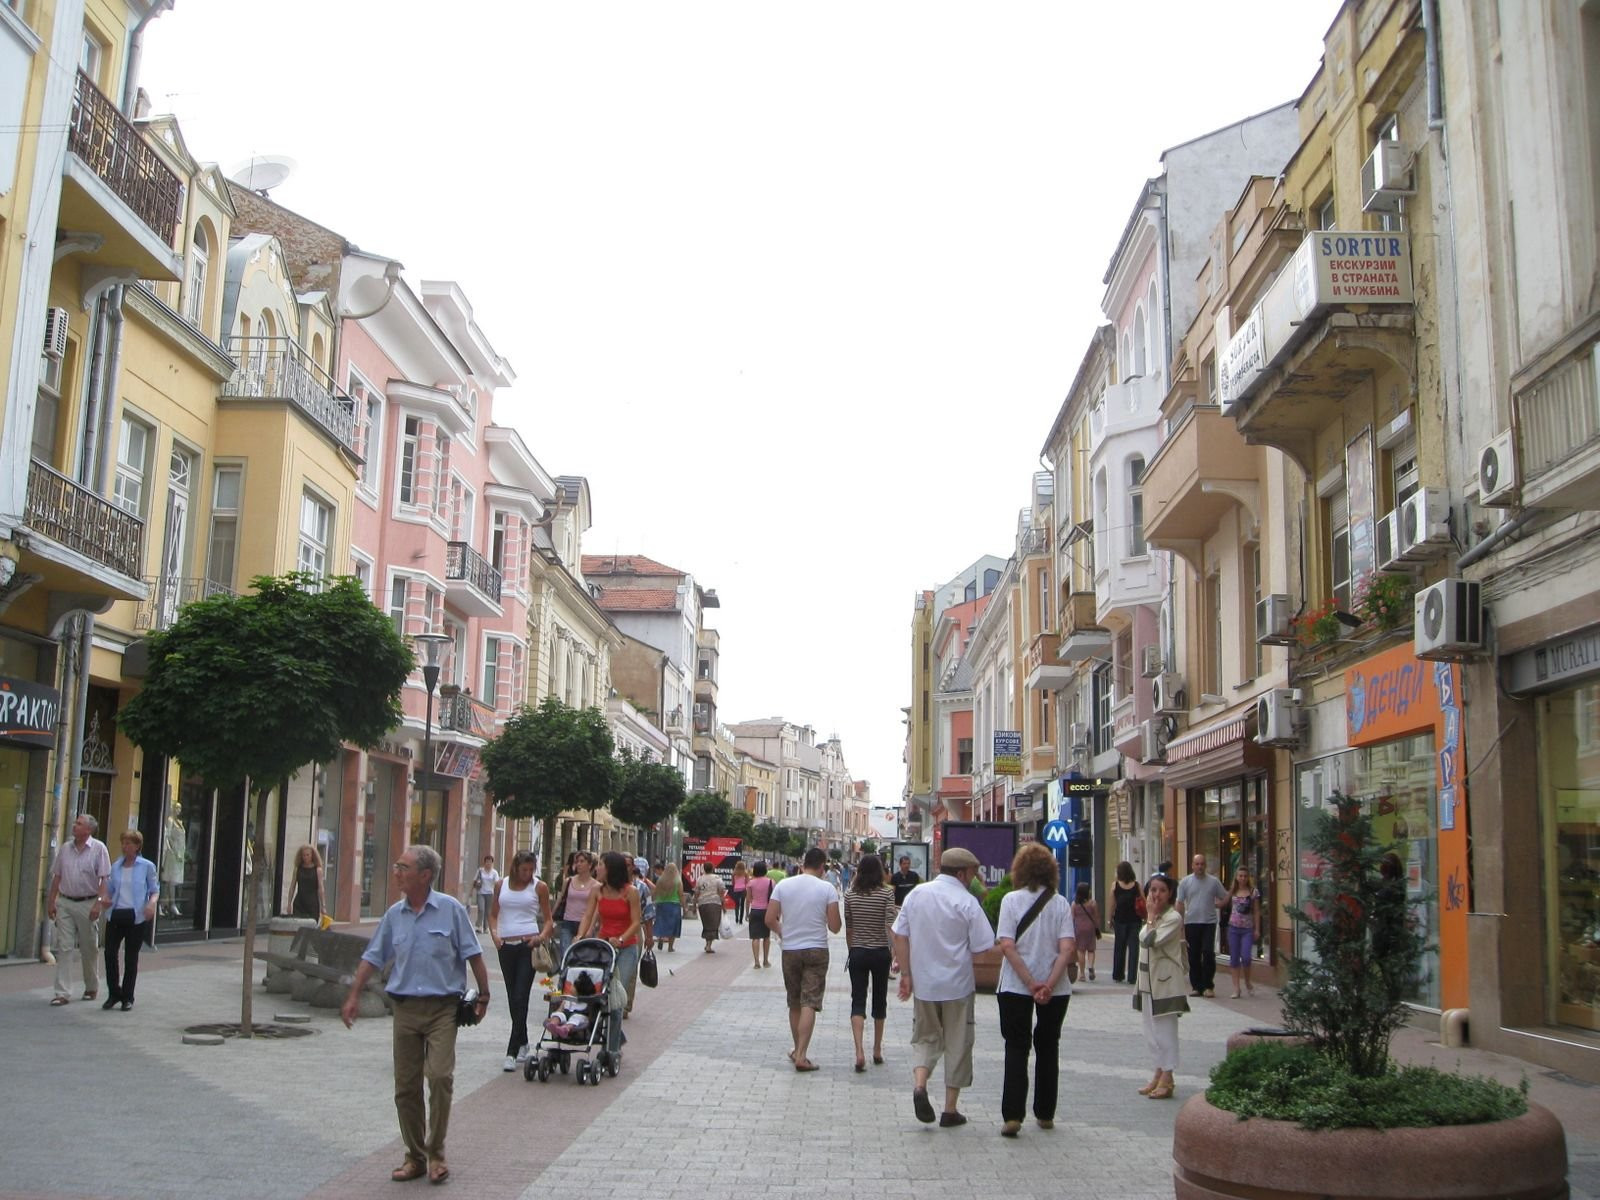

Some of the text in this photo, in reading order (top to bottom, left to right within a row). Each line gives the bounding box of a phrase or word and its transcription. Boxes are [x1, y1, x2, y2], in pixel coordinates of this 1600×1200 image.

[1322, 237, 1402, 257] SORTUR
[1330, 260, 1396, 271] ЕКСКУРЗИИ
[1332, 272, 1398, 283] В СТРАНАТА
[1333, 285, 1400, 296] И ЧУЖБИНА
[1365, 661, 1425, 727] ДЕНДИ
